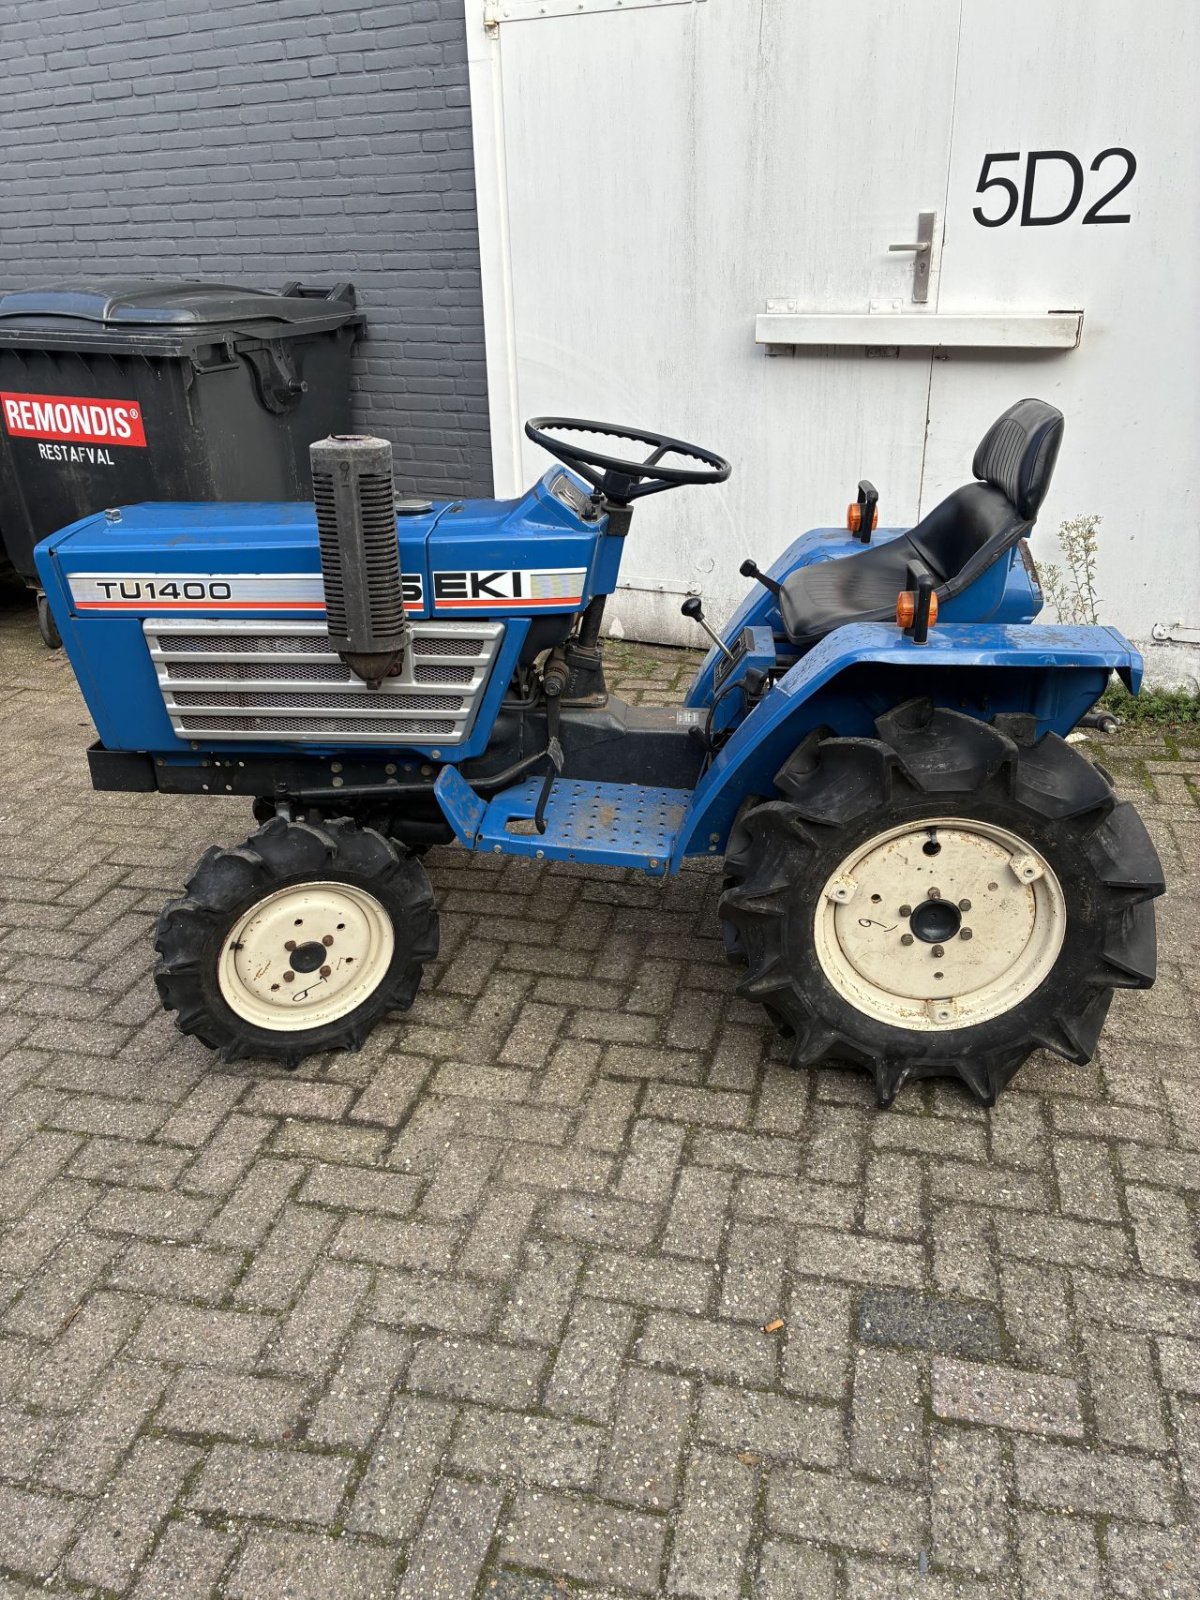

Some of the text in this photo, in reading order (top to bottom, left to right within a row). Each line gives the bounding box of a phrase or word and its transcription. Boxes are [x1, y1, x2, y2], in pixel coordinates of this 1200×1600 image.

[972, 147, 1137, 227] 5D2
[38, 443, 115, 465] RESTAFVAL
[96, 582, 232, 600] TU1400
